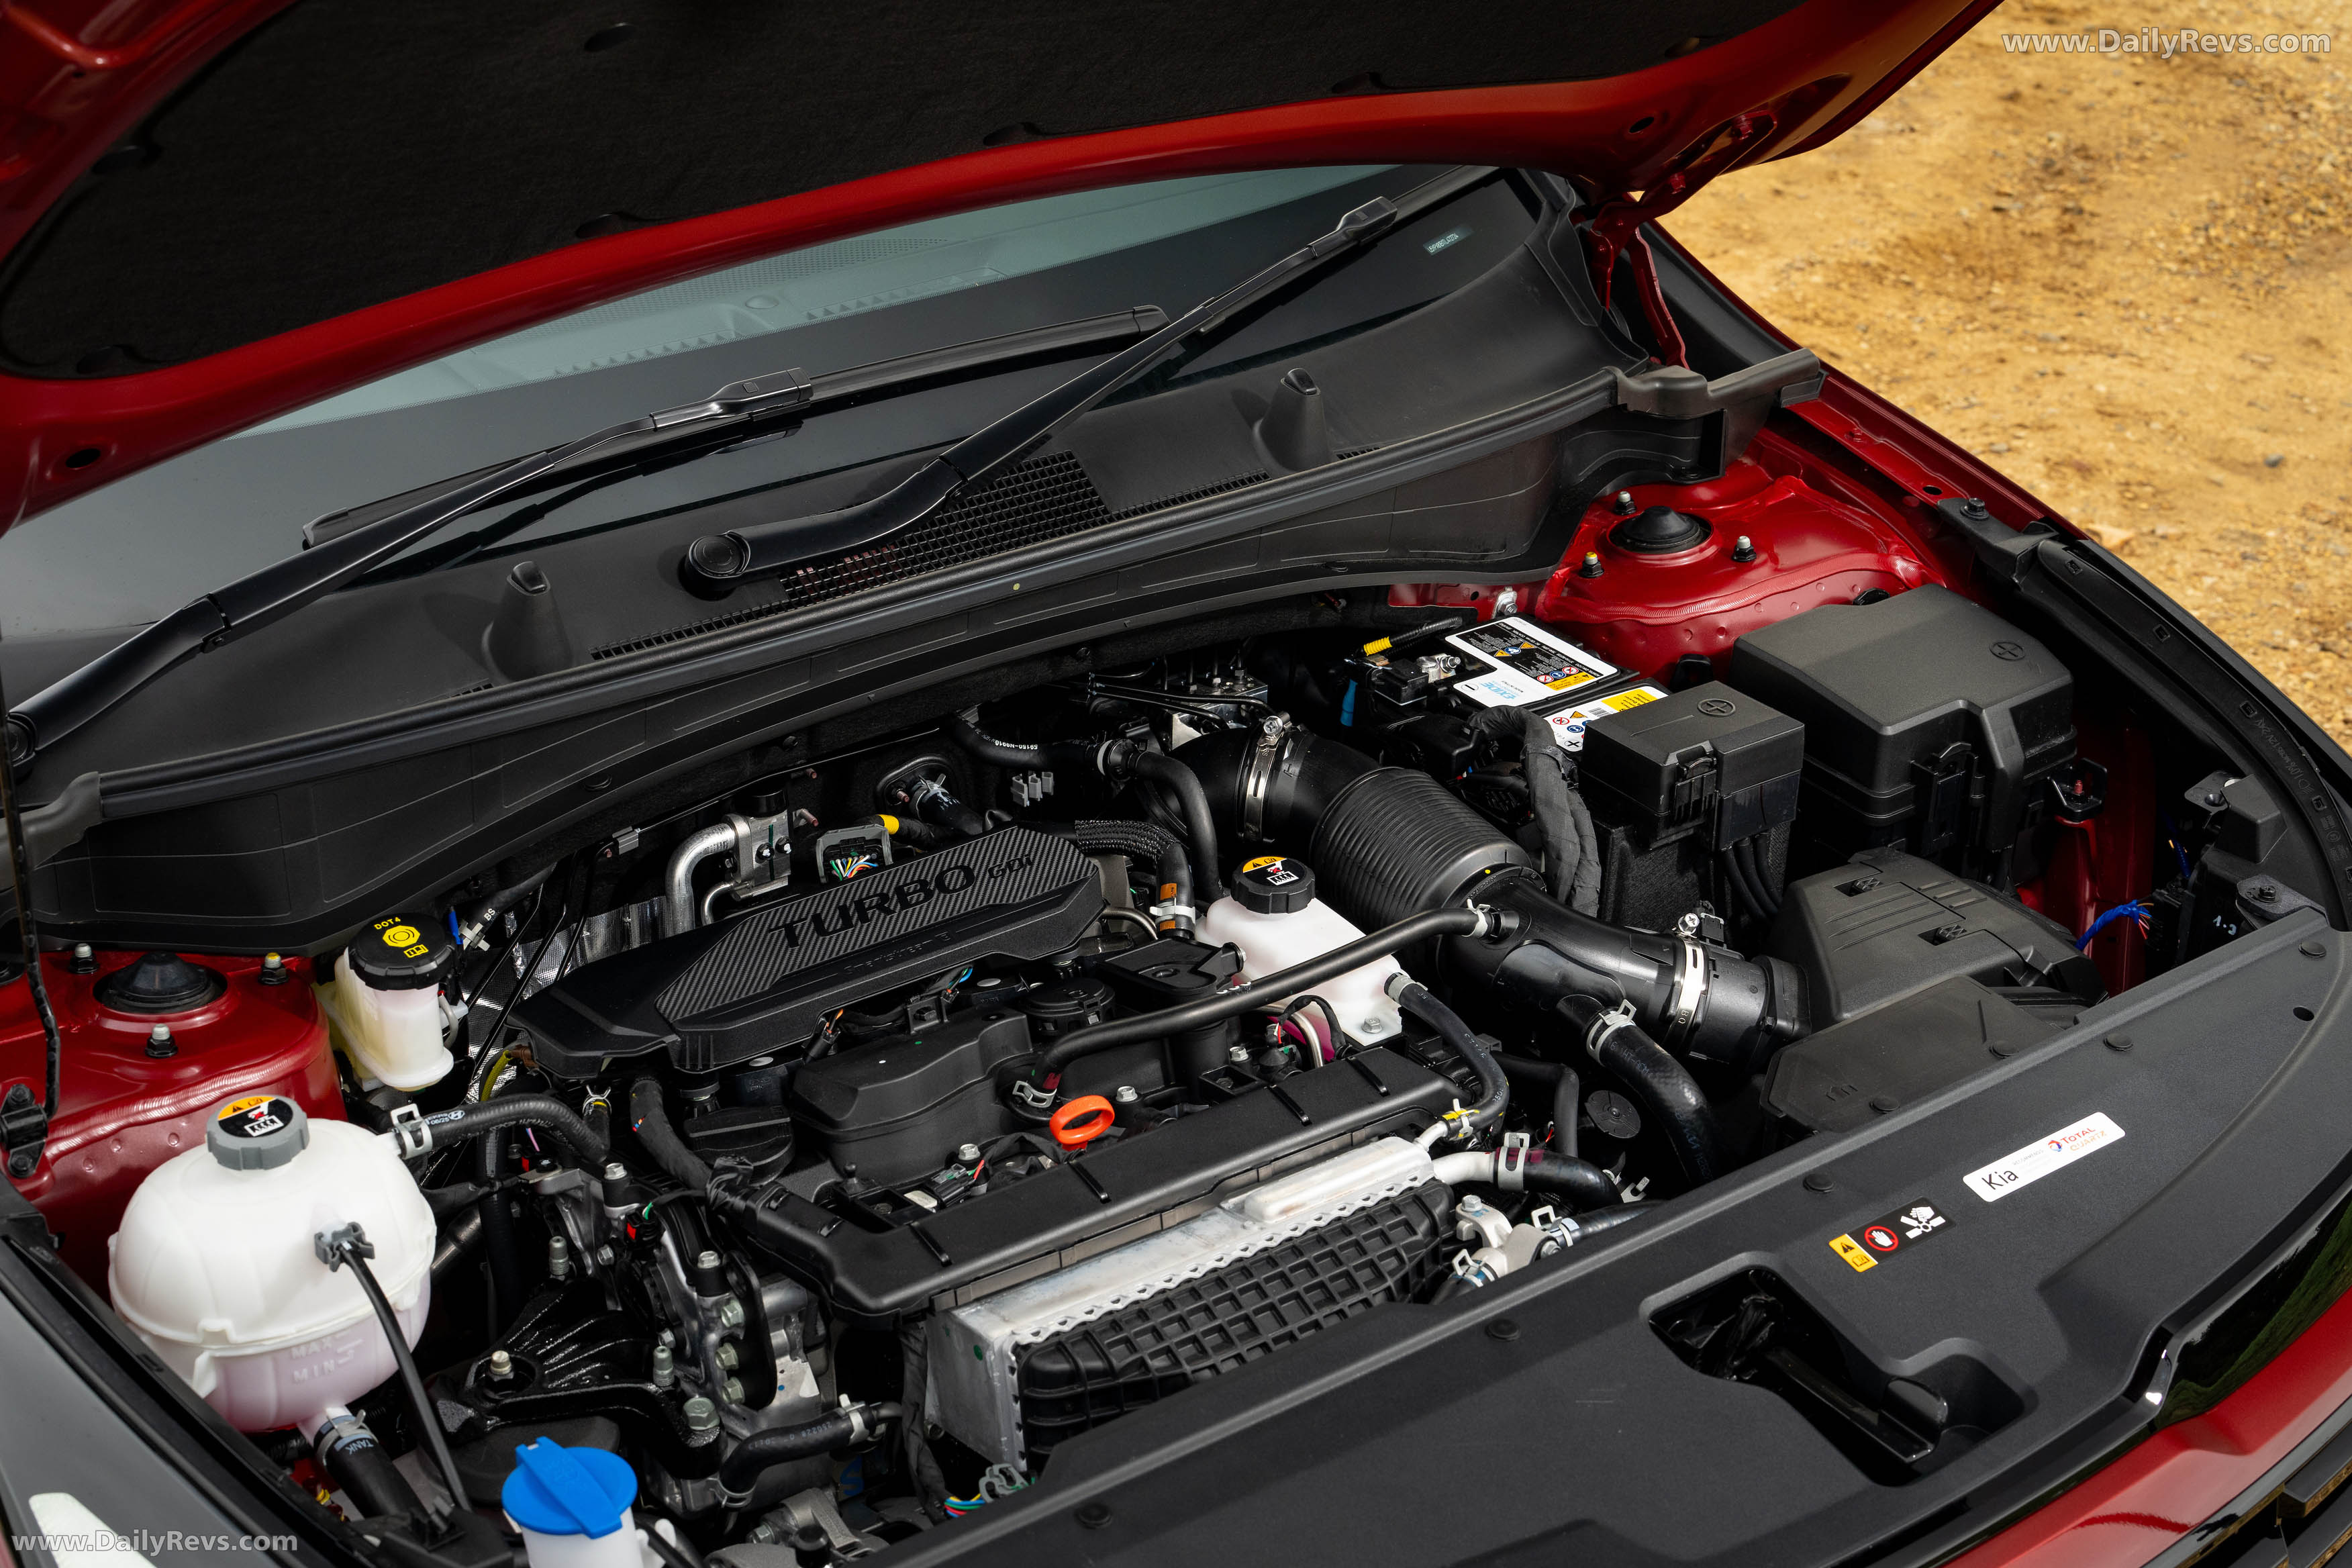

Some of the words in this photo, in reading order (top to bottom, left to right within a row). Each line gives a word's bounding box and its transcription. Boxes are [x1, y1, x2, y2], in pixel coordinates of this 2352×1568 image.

[1480, 681, 1518, 699] EXIDE
[769, 865, 975, 948] TURBO
[987, 852, 1034, 879] GDi
[373, 919, 395, 930] DOT
[483, 908, 496, 922] BS
[1981, 1168, 2020, 1191] Kia
[291, 1338, 333, 1360] MAX
[293, 1359, 336, 1383] MIN
[345, 1440, 375, 1455] TANK
